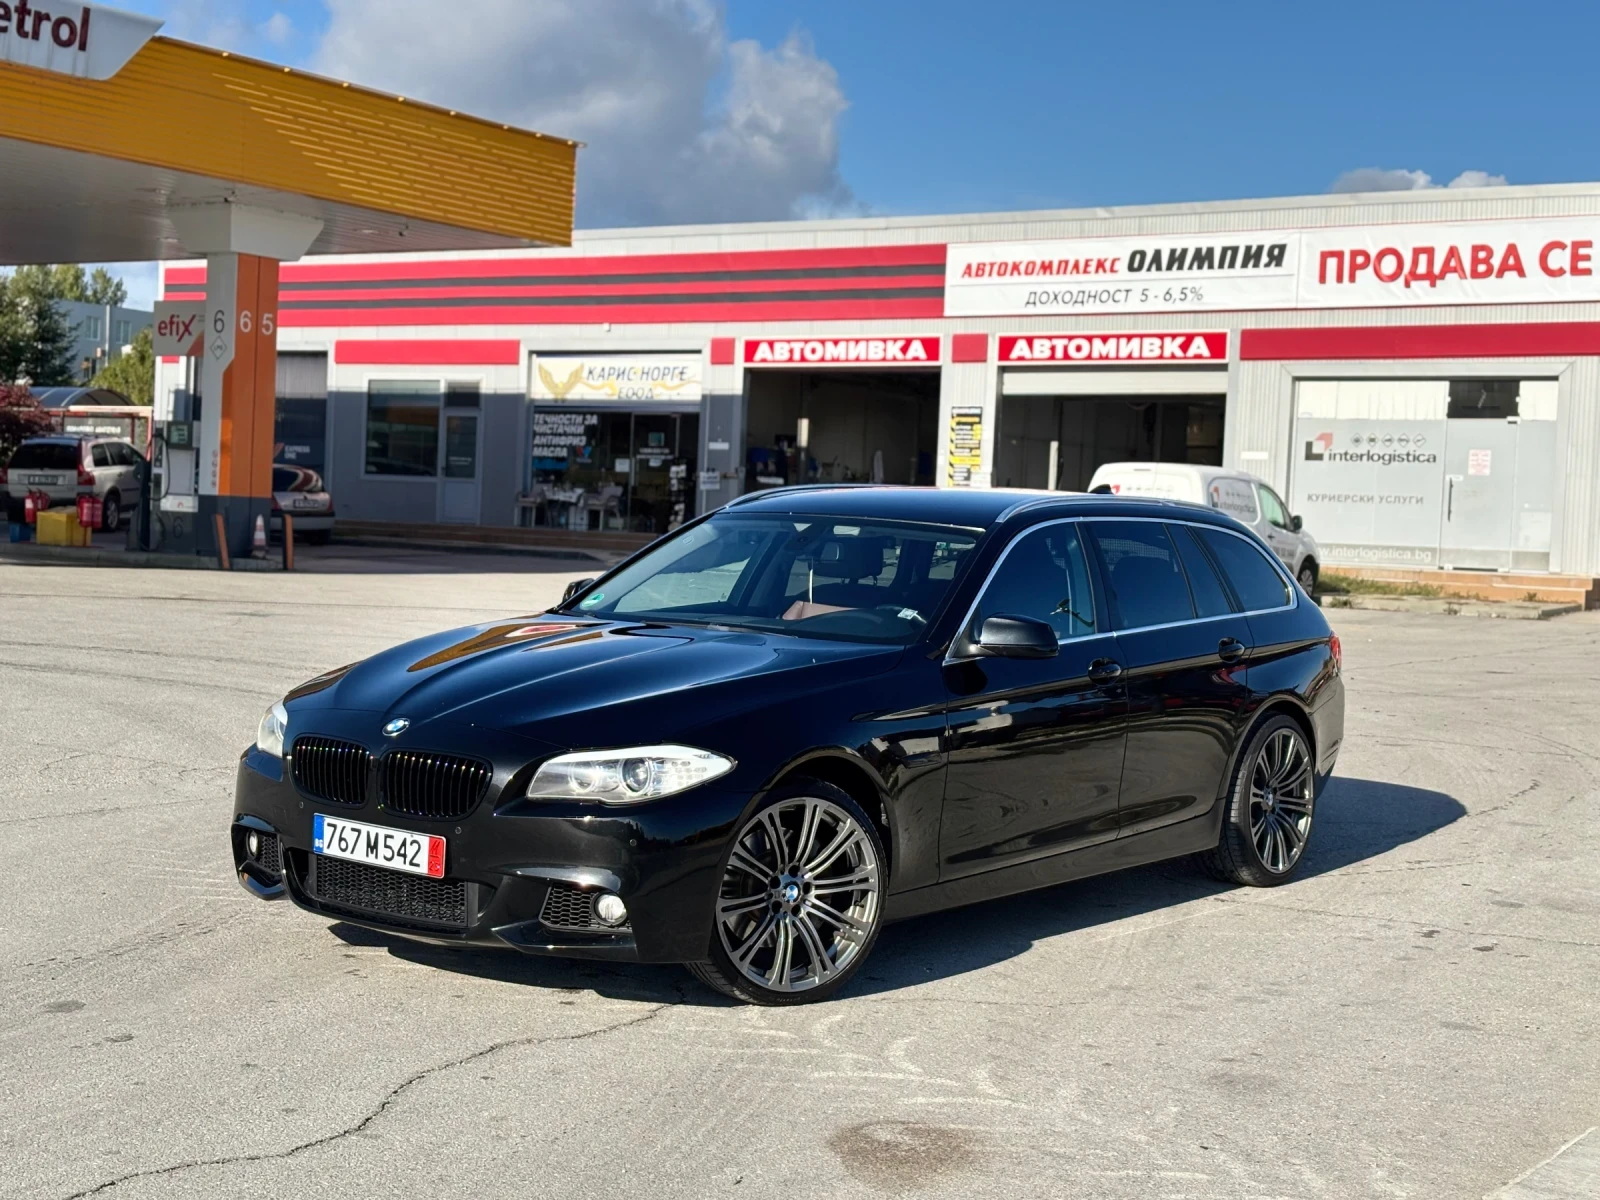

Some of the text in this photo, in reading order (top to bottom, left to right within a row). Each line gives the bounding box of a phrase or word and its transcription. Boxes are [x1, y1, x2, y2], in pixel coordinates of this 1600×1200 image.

[961, 243, 1287, 279] АВТОКОМПЛЕКС ОЛИМПИЯ
[1319, 240, 1593, 289] ПРОДАВА СЕ
[1025, 289, 1133, 307] ДОХОДНОСТ
[1139, 288, 1150, 303] 5
[1162, 286, 1204, 304] 6,5%
[157, 313, 197, 343] efix
[213, 310, 225, 333] 6
[239, 310, 252, 333] 6
[261, 313, 274, 335] 5
[752, 339, 928, 362] АВТОМИВКА
[1008, 336, 1212, 360] АВТОМИВКА
[586, 366, 688, 382] КАРИС НОРГЕ
[618, 387, 654, 400] ЕООД
[533, 413, 598, 425] ТЕЧНОСТИ ЗА
[533, 424, 584, 434] ЧИСТАЧКИ
[533, 435, 586, 446] АНТИФРИЗ
[532, 447, 567, 457] МАСЛА
[1329, 449, 1436, 465] interlogistica
[1307, 493, 1424, 505] КУРИЕРСКИ УСЛУГИ
